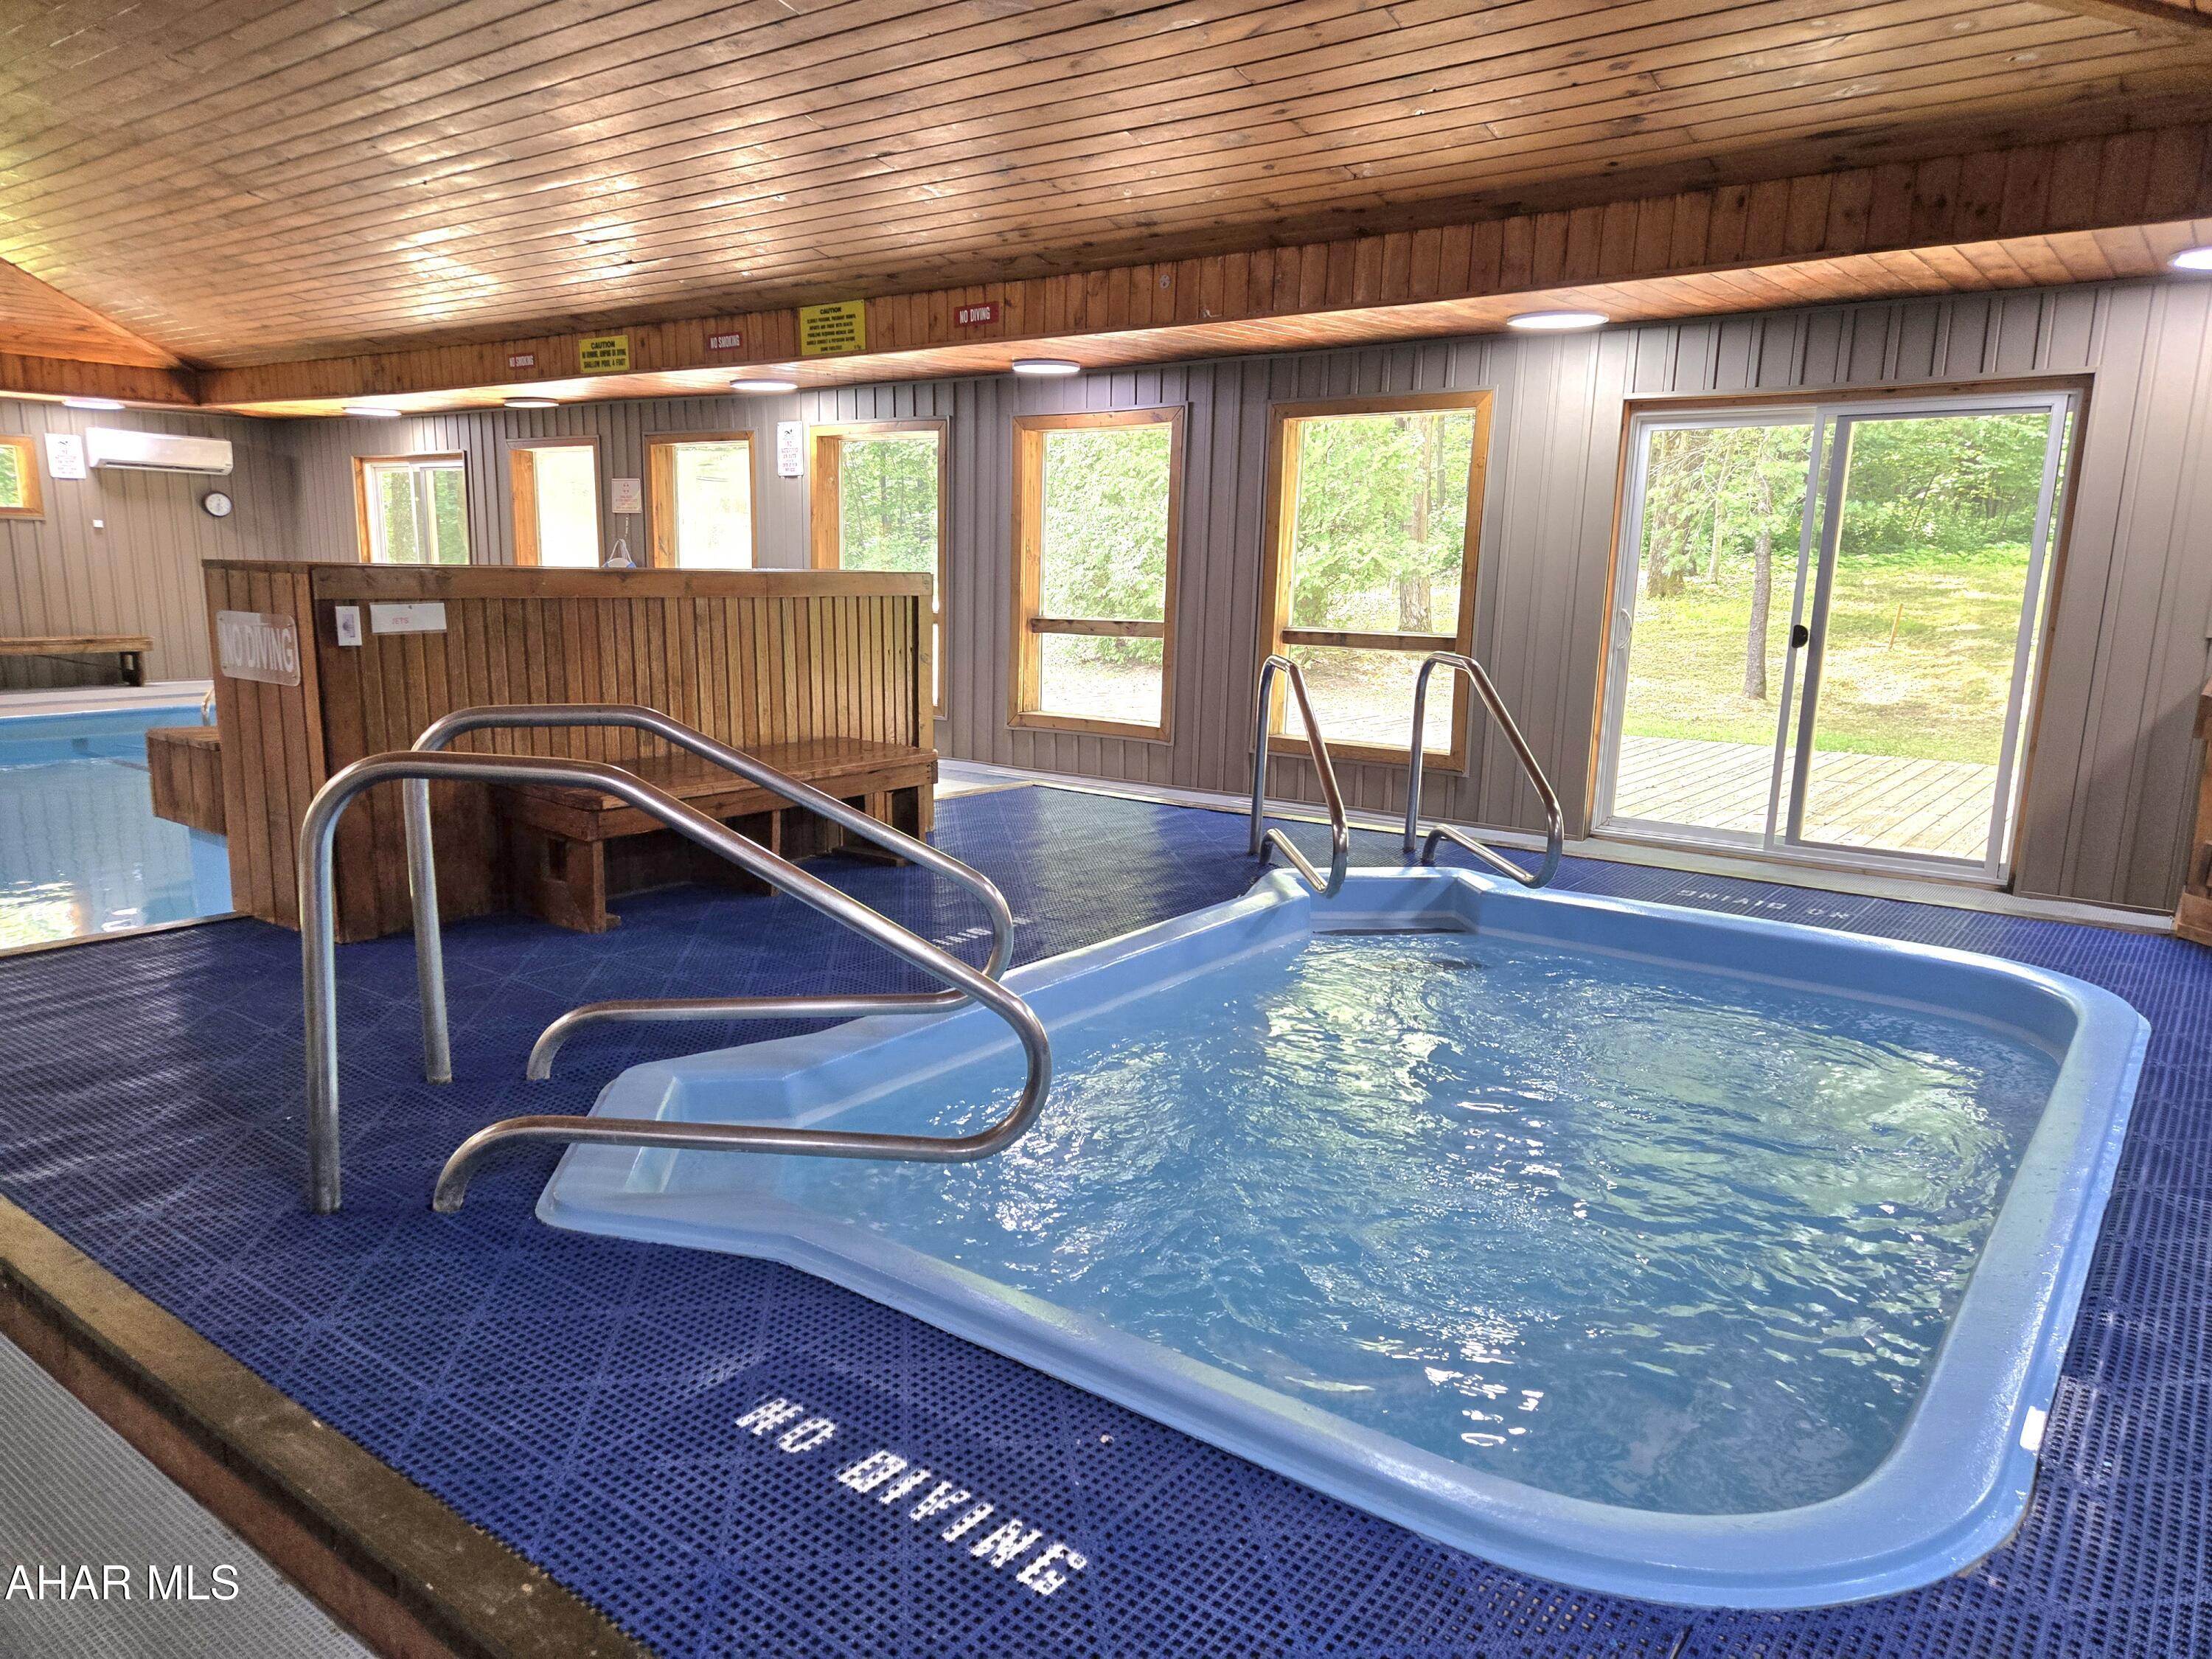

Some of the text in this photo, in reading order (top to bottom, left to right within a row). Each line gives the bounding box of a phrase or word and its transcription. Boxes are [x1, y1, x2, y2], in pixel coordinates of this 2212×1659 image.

[819, 307, 842, 315] CAUTION
[959, 306, 990, 324] NO DIVING
[591, 341, 616, 349] CAUTION
[710, 335, 740, 349] NO SMOKING
[509, 355, 534, 367] NO SMOKING
[223, 624, 293, 672] NO DIVING
[1677, 889, 1787, 910] DIVING
[736, 1397, 1088, 1596] NO DIVING
